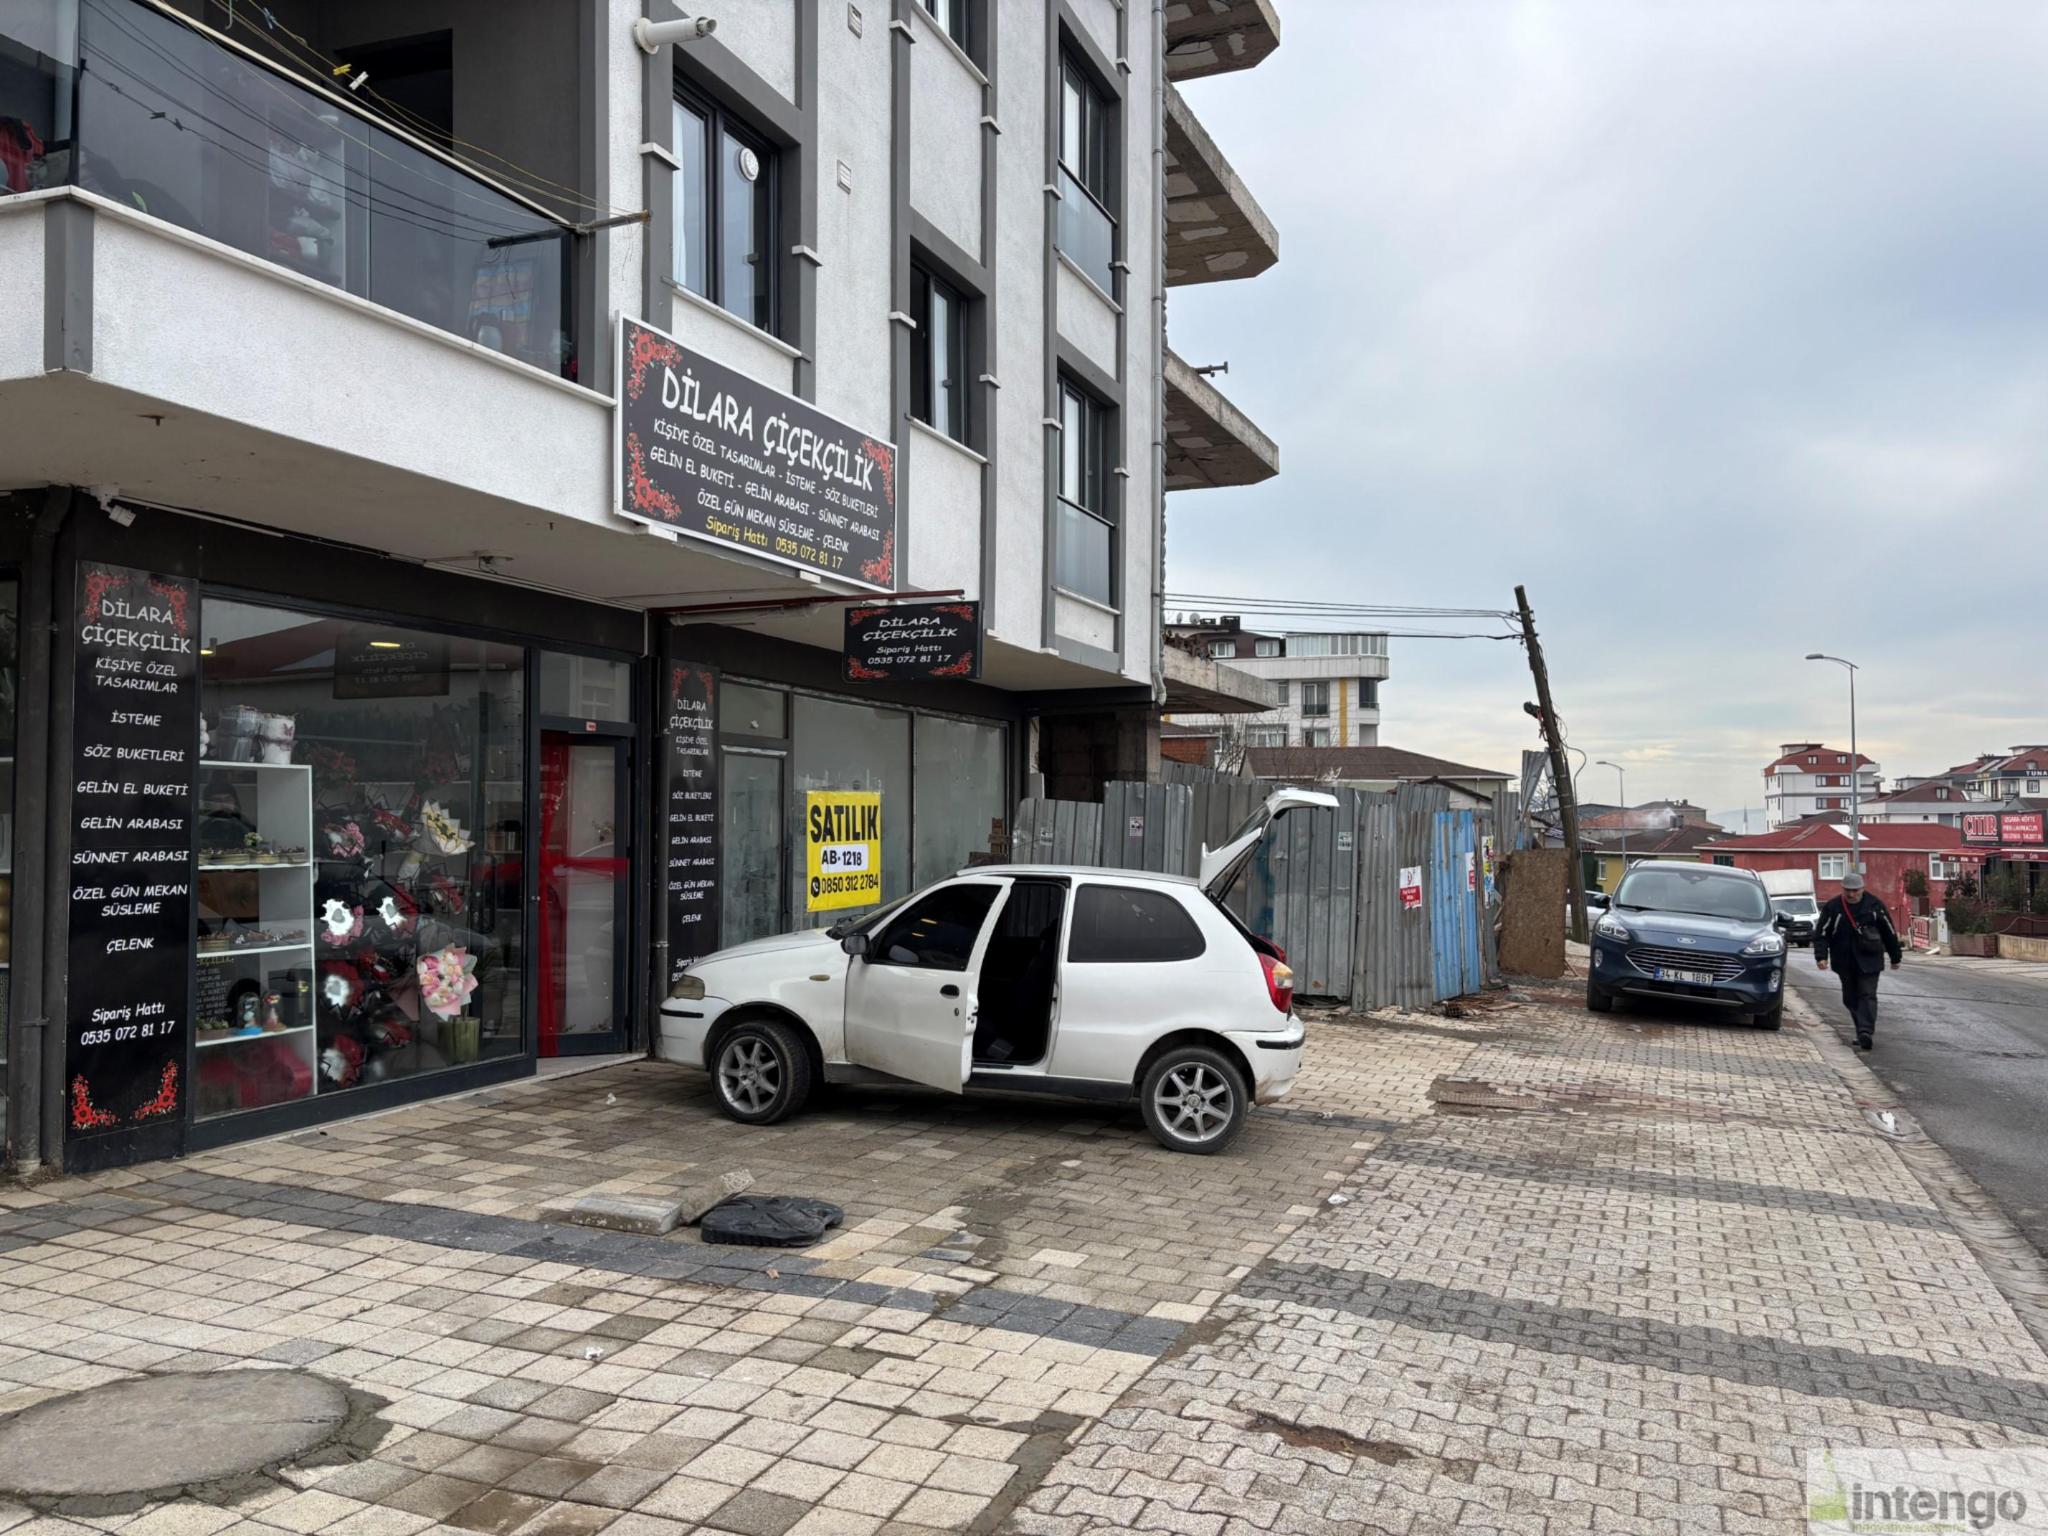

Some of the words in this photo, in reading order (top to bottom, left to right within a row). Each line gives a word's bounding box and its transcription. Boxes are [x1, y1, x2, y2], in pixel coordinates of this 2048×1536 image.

[662, 366, 753, 441] DİLARA
[763, 412, 874, 492] ÇİÇEKÇİLİK
[654, 418, 690, 445] KİŞİYE
[692, 431, 716, 455] ÖZEL
[721, 445, 775, 478] TASARIMLAR
[786, 469, 816, 495] İSTEME
[824, 487, 840, 504] SÖZ
[842, 494, 879, 518] BUKETLERİ
[650, 446, 683, 470] GELİN
[685, 458, 697, 475] EL
[700, 464, 735, 488] BUKETİ
[745, 481, 772, 501] GELİN
[774, 493, 810, 515] ARABASI
[818, 508, 848, 529] SÜNNET
[850, 521, 880, 541] ARABASI
[697, 488, 721, 511] ÖZEL
[724, 499, 744, 518] GÜN
[746, 508, 776, 529] MEKAN
[778, 518, 815, 542] SÜSLEME
[822, 534, 850, 553] ÇELENK
[706, 515, 740, 541] Sipariş
[744, 526, 768, 547] Hattı
[775, 536, 798, 556] 0535
[800, 544, 816, 561] 072
[819, 550, 829, 565] 81
[832, 555, 843, 569] 17
[101, 598, 174, 625] DİLARA
[879, 616, 941, 628] DİLARA
[81, 623, 191, 653] ÇİÇEKÇİLİK
[862, 627, 958, 642] ÇİÇEKÇİLİK
[876, 645, 911, 656] Sipariş
[914, 644, 942, 652] Hattı
[95, 655, 142, 673] KİŞİYE
[146, 659, 177, 676] ÖZEL
[867, 656, 893, 665] 0535
[896, 656, 915, 664] 072
[920, 655, 931, 663] 81
[937, 654, 951, 662] 17
[95, 675, 178, 694] TASARIMLAR
[677, 697, 706, 711] DİLARA
[110, 709, 161, 727] İSTEME
[670, 714, 713, 730] ÇİÇEKÇİLİK
[84, 744, 112, 758] SÖZ
[117, 747, 184, 762] BUKETLERİ
[77, 779, 119, 794] GELİN
[123, 782, 138, 794] EL
[143, 782, 188, 796] BUKETİ
[81, 816, 122, 830] GELİN
[127, 818, 183, 830] ARABASI
[810, 805, 878, 843] SATILIK
[72, 851, 129, 864] SÜNNET
[133, 850, 189, 863] ARABASI
[72, 886, 106, 900] ÖZEL
[111, 884, 141, 898] GÜN
[143, 884, 188, 897] MEKAN
[821, 876, 844, 894] 0850
[845, 875, 859, 892] 312
[860, 873, 879, 889] 2784
[101, 902, 161, 917] SÜSLEME
[106, 937, 154, 954] ÇELENK
[91, 1005, 131, 1024] Sipariş
[135, 1003, 165, 1018] Hattı
[81, 1028, 111, 1045] 0535
[115, 1025, 137, 1040] 072
[141, 1023, 154, 1037] 81
[160, 1021, 175, 1034] 17
